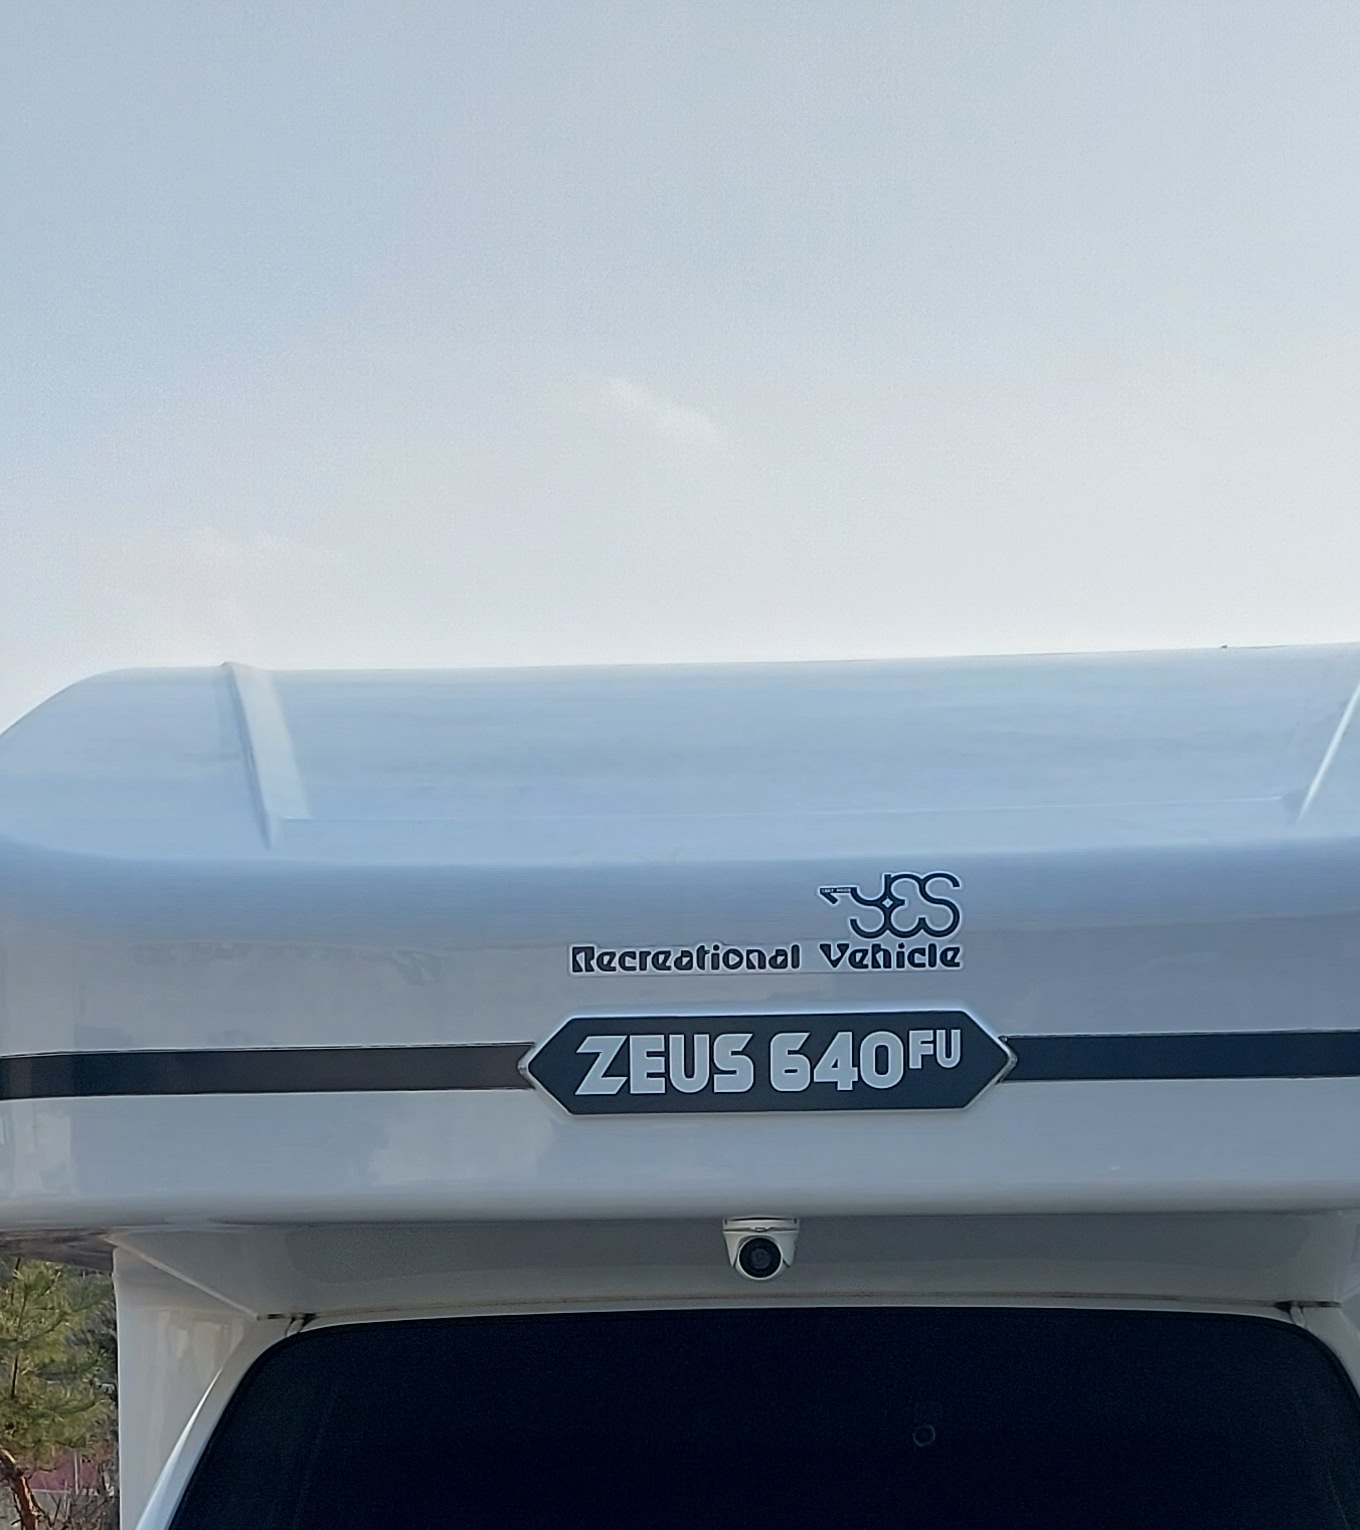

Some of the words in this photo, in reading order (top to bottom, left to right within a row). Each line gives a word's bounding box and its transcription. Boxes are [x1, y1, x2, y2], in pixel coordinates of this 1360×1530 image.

[571, 944, 801, 973] Recreational
[820, 942, 962, 970] Vehicle
[575, 1033, 754, 1096] ZEUS
